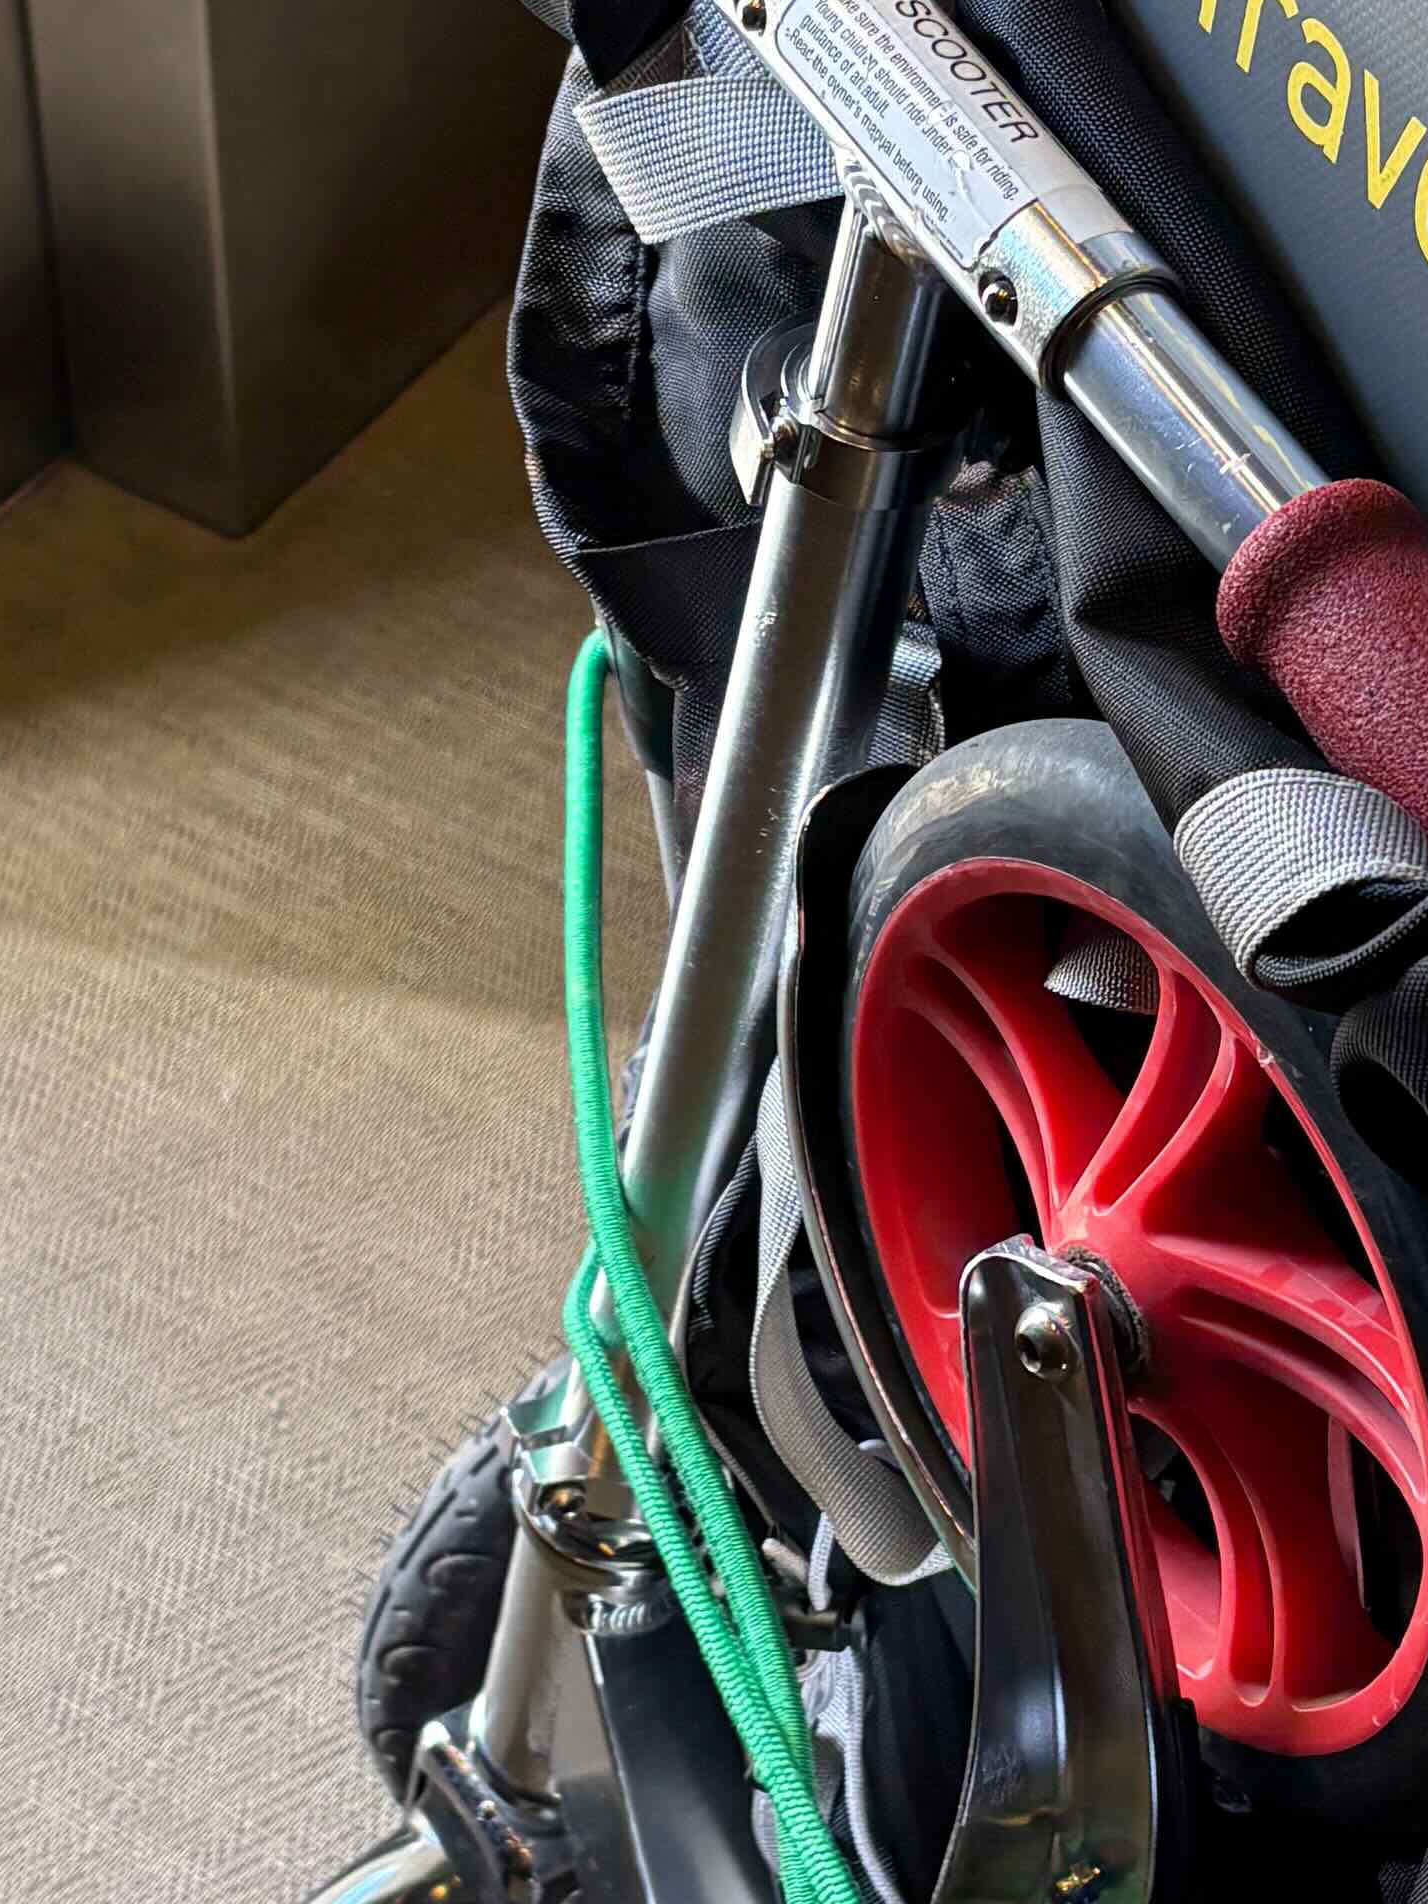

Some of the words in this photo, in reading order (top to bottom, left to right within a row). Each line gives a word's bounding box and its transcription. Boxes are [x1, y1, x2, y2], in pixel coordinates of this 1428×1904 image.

[800, 15, 842, 63] guidance
[840, 59, 855, 75] of
[850, 71, 866, 89] an
[854, 13, 880, 36] sure
[875, 34, 895, 55] the
[942, 112, 958, 127] is
[953, 127, 978, 150] safe
[972, 148, 993, 167] for
[986, 166, 1019, 201] riding.
[874, 68, 911, 105] should
[905, 102, 927, 126] ride
[896, 0, 1039, 142] SCOOTER
[812, 54, 829, 79] the
[892, 151, 924, 190] before
